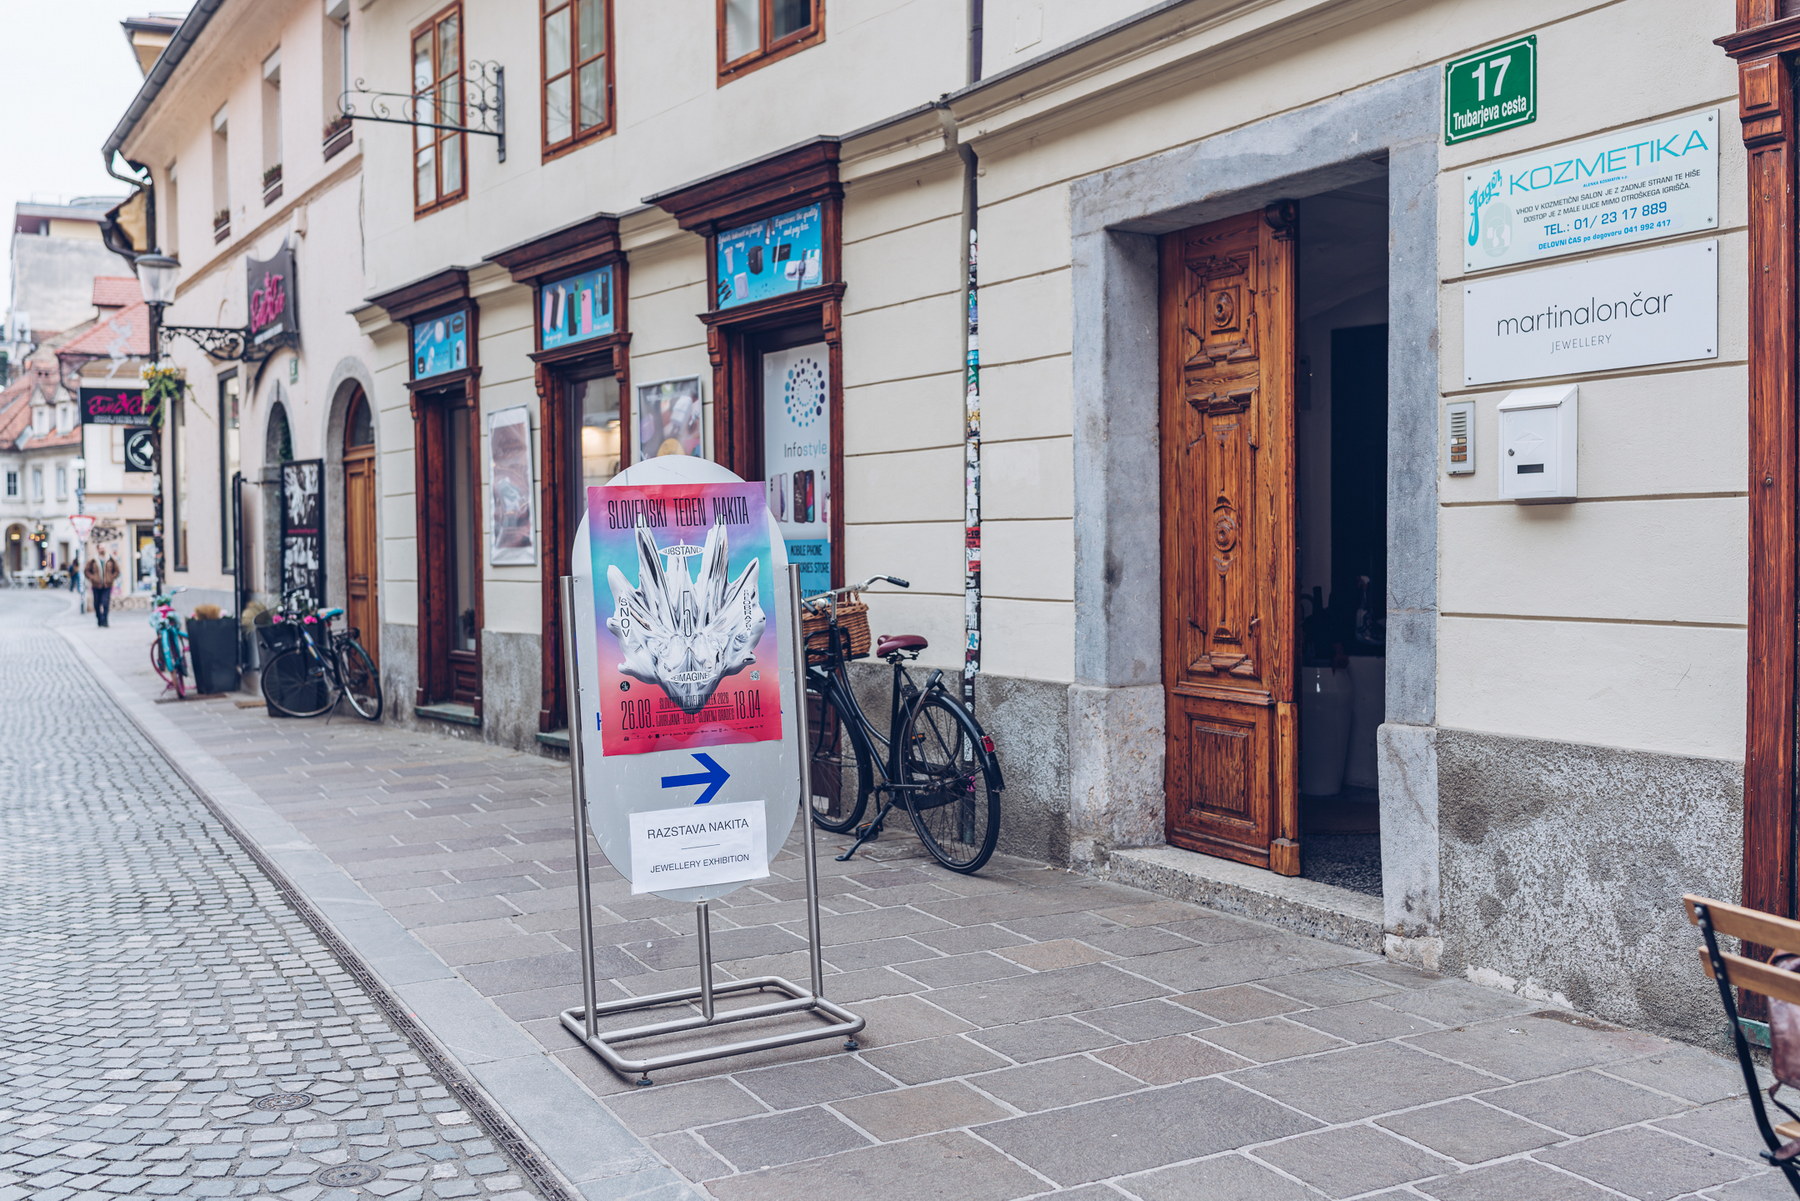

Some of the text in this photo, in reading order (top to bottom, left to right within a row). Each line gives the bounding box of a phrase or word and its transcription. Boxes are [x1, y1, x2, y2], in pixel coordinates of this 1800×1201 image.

[1472, 55, 1511, 101] 17
[1453, 95, 1526, 130] Trubarjeva cesta
[1510, 130, 1708, 195] KOZMETIKA
[1516, 206, 1533, 215] VHOD
[1540, 196, 1580, 210] KOZMETIČNI
[1580, 190, 1602, 201] SALON
[1620, 181, 1646, 192] ZADNJE
[1648, 176, 1673, 186] STRANI
[1684, 169, 1700, 178] HIŠE
[1524, 213, 1548, 224] DOSTOP
[1562, 204, 1580, 214] MALE
[1582, 201, 1600, 210] ULICE
[1601, 197, 1620, 207] MIMO
[1622, 189, 1660, 202] OTROŠKEGA
[1544, 223, 1570, 236] TEL.:
[1601, 212, 1617, 224] 23
[1622, 207, 1637, 220] 17
[1642, 201, 1668, 216] 889
[1538, 238, 1566, 250] DELOVNI
[1568, 235, 1582, 246] ČAS
[1592, 229, 1622, 241] dogovoru
[1624, 226, 1638, 234] 041
[1640, 222, 1654, 232] 992
[1656, 220, 1672, 228] 417
[1497, 291, 1672, 336] martinalončar
[1550, 334, 1612, 354] JEWELLERY
[784, 440, 828, 458] Infostyle
[608, 496, 750, 530] SLOVENSKI TEDEN NAKITA
[790, 544, 822, 556] MOBILE PHONE
[814, 562, 830, 574] STORE
[620, 698, 655, 730] 26.03.
[734, 690, 764, 720] 18.04.
[648, 818, 750, 840] RAZSTAVA NAKITA
[650, 854, 750, 874] JEWELLERY EXHIBITION
